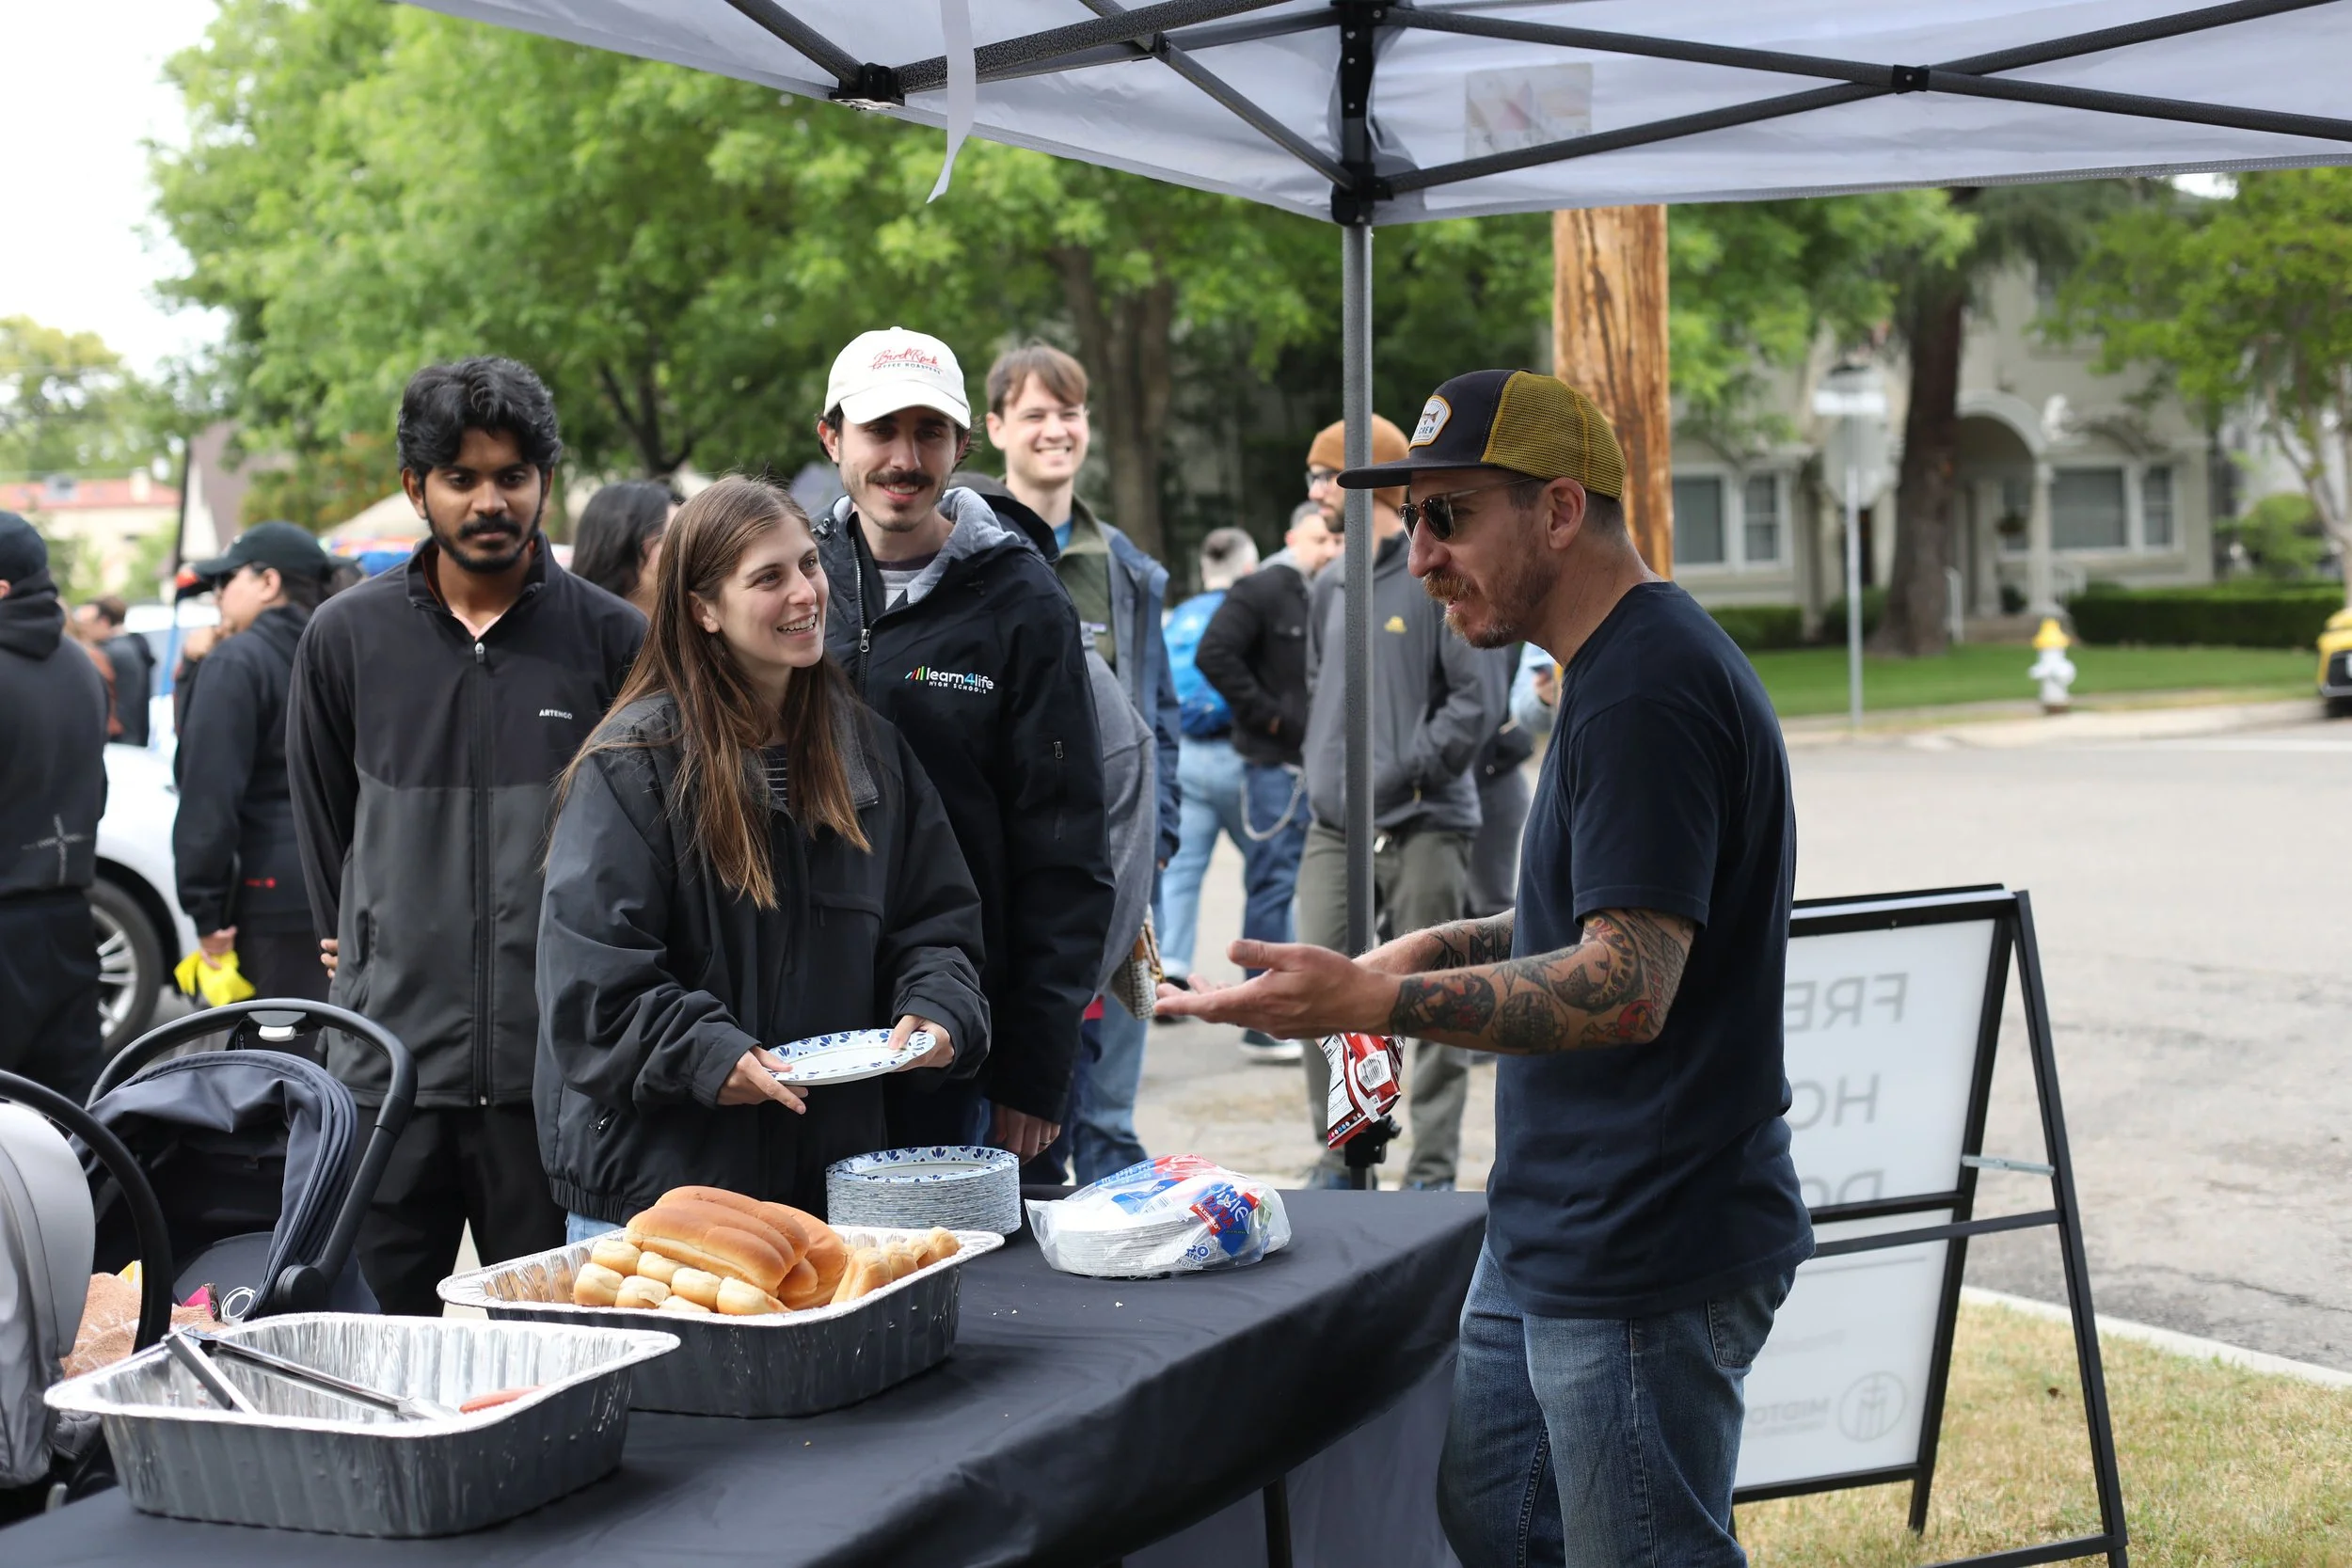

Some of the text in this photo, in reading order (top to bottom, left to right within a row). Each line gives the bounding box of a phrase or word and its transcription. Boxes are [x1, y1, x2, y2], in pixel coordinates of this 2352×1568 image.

[926, 667, 994, 689] learn4life
[953, 683, 987, 694] SCHOOLS
[539, 708, 573, 720] ARTENGO
[1184, 1251, 1202, 1262] ATES
